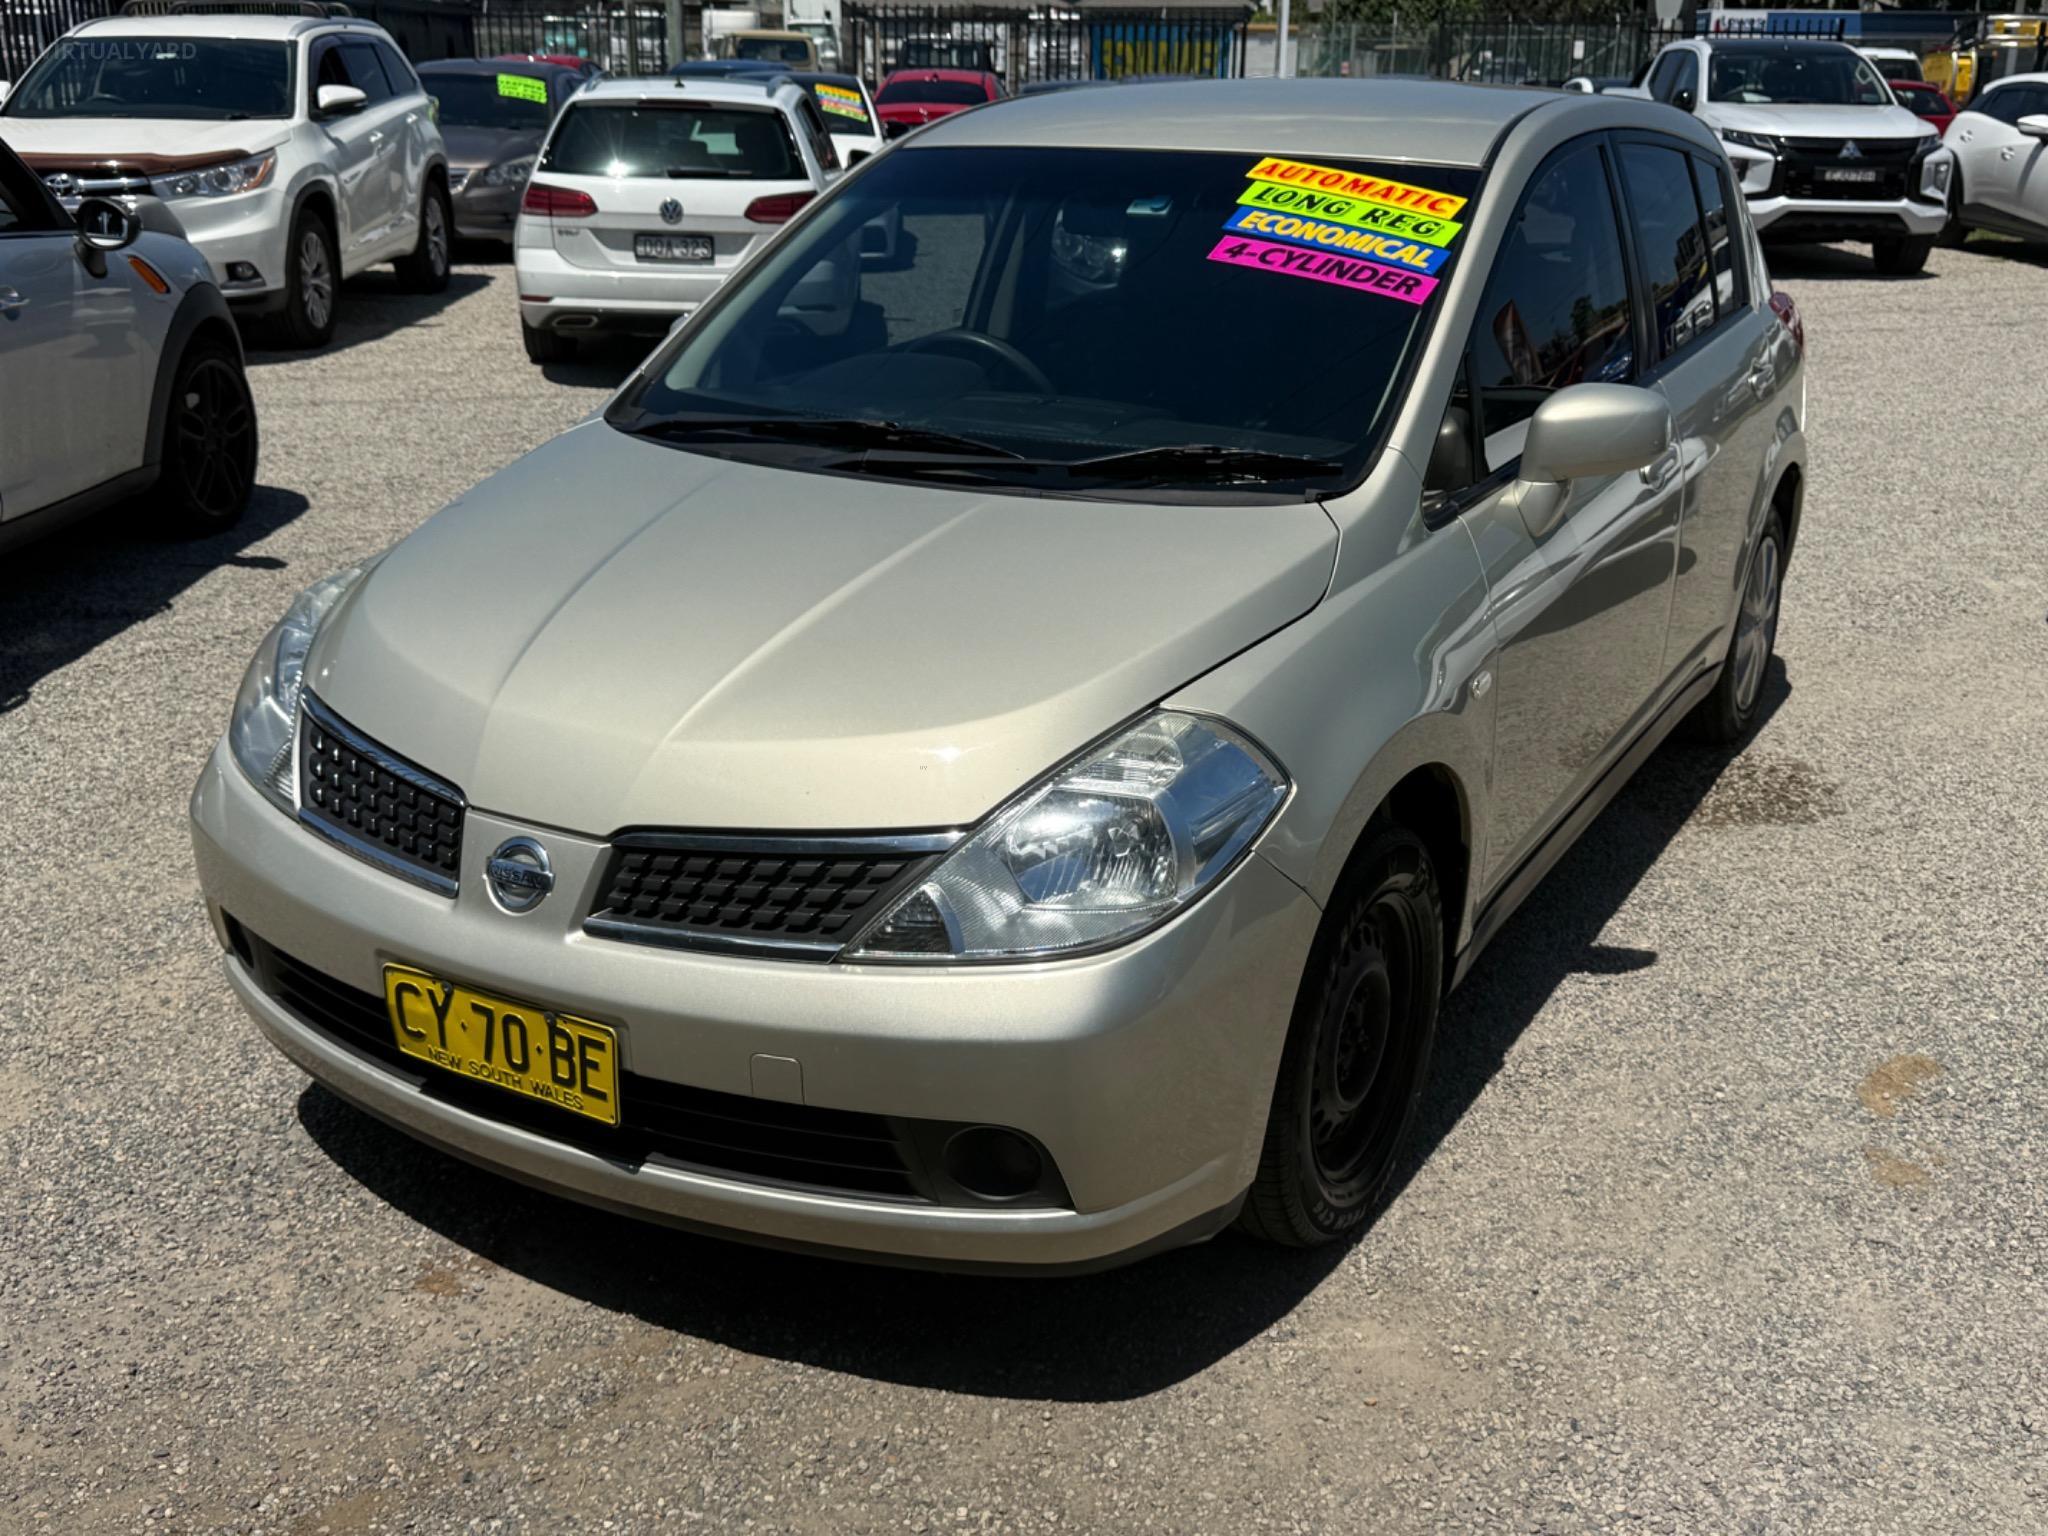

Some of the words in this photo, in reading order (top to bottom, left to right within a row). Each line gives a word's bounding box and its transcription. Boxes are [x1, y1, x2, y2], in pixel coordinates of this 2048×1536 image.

[1253, 187, 1353, 216] LONG
[1358, 207, 1443, 236] REG
[1255, 162, 1457, 213] AUTOMATIC
[1237, 210, 1434, 268] ECONOMICAL
[1223, 242, 1423, 295] 4-CYLINDER
[491, 864, 545, 889] NISSAN
[428, 1045, 461, 1069] NEW
[468, 1060, 522, 1089] SOUTH
[529, 1078, 585, 1110] WALES
